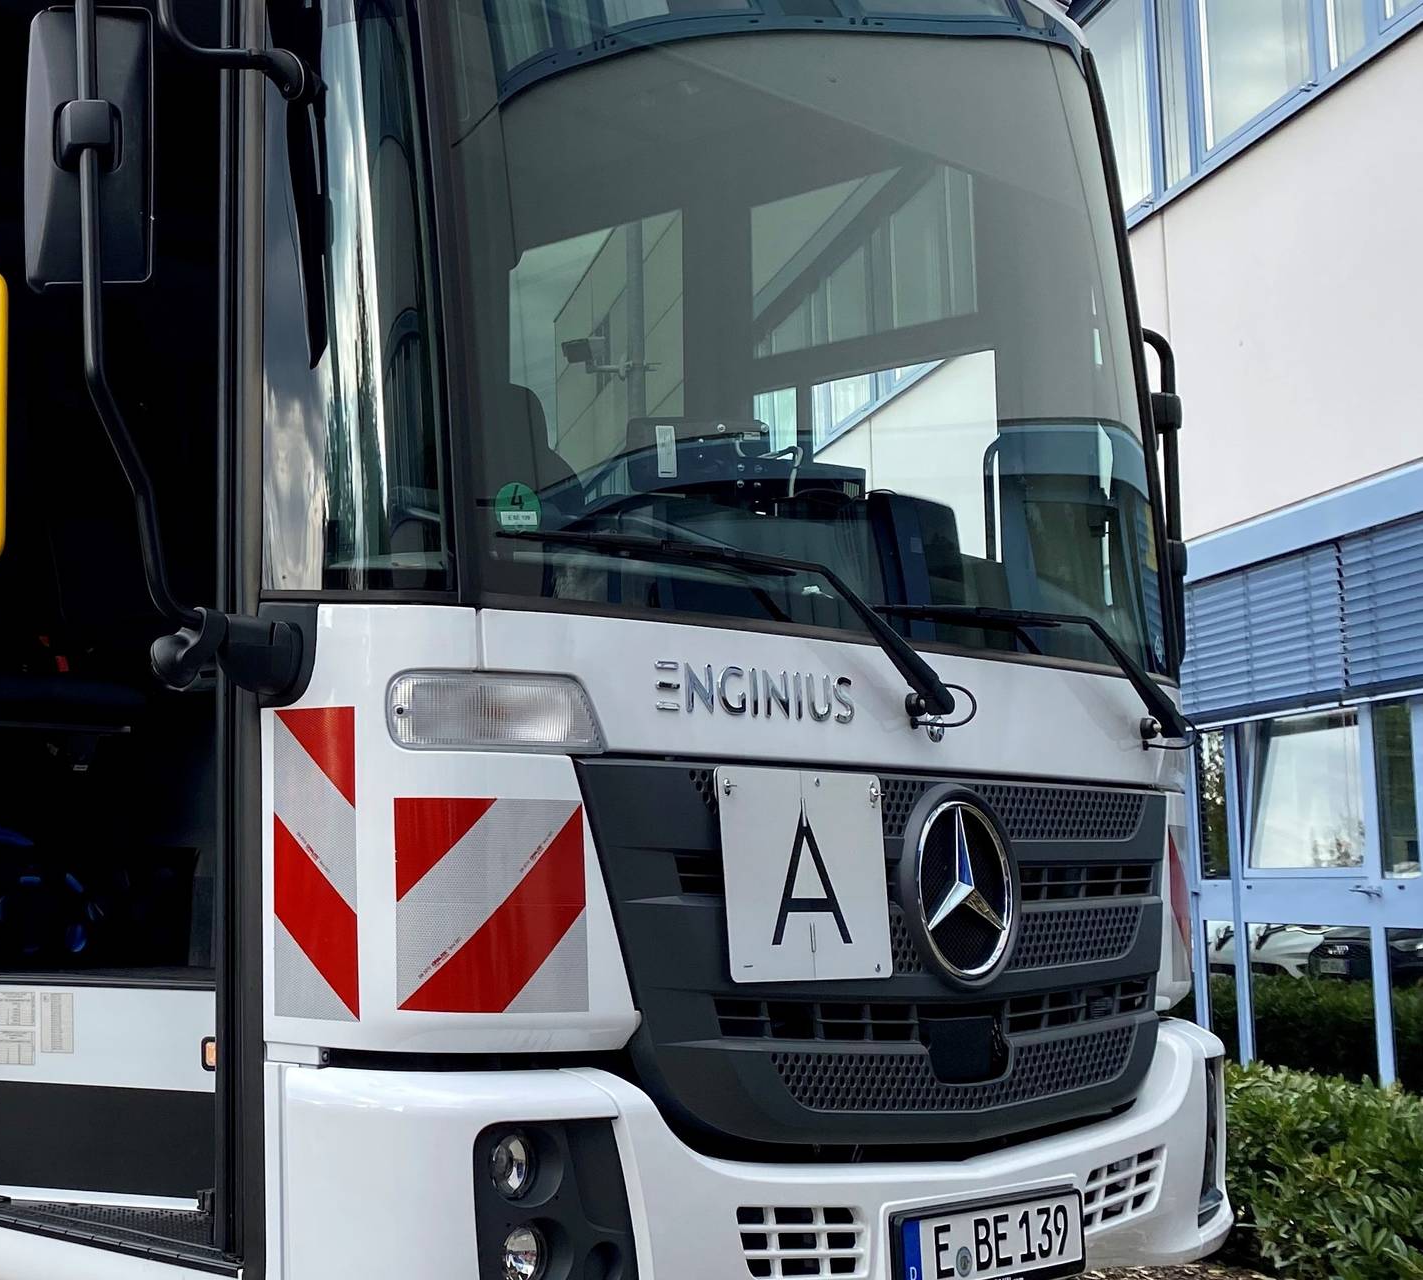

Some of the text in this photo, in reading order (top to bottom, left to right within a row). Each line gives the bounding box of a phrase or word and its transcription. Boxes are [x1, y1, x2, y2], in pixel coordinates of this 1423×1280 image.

[511, 484, 524, 510] 4
[654, 660, 855, 724] ENGINIUS
[772, 810, 853, 946] A
[934, 1205, 1069, 1279] E BE 139
